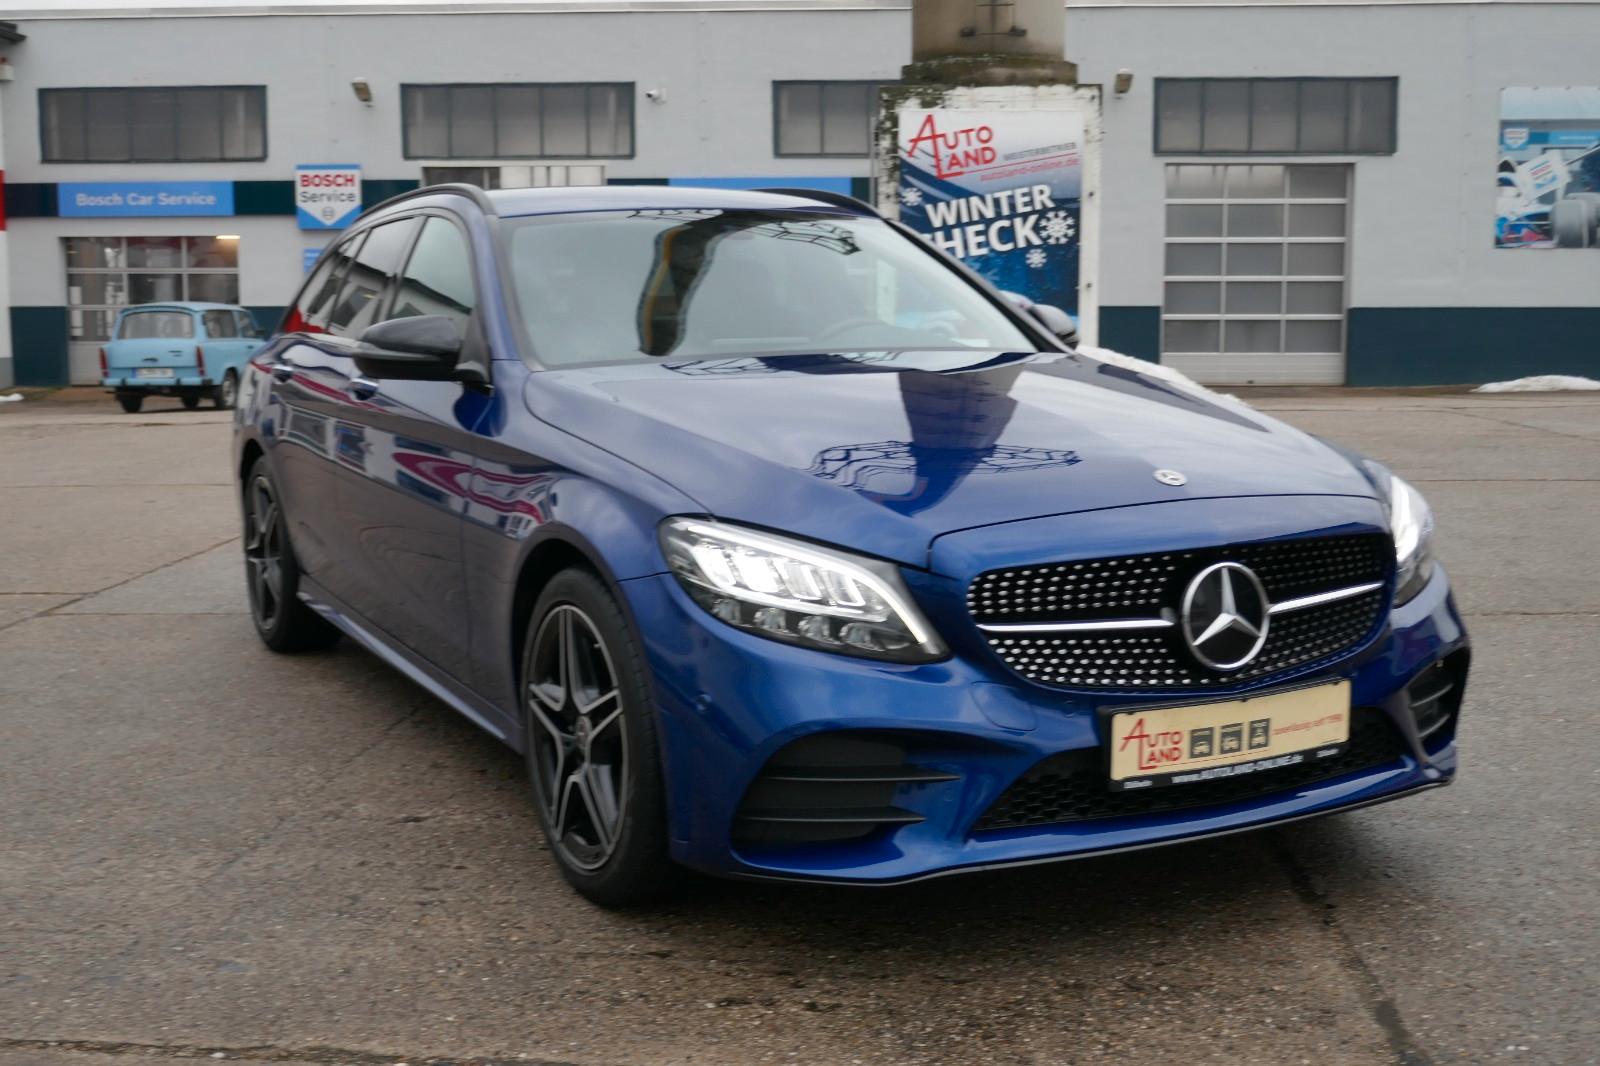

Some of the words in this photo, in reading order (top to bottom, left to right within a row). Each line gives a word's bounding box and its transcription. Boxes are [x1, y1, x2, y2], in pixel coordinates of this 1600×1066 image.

[907, 114, 994, 157] AUTO
[933, 146, 997, 181] LAND
[299, 173, 356, 188] BOSCH
[75, 193, 123, 206] Bosch
[126, 193, 154, 206] Car
[158, 192, 216, 205] Service
[299, 190, 357, 203] Service
[925, 184, 1056, 228] WINTER
[1119, 717, 1184, 752] AUTO
[1137, 745, 1183, 771] LAND
